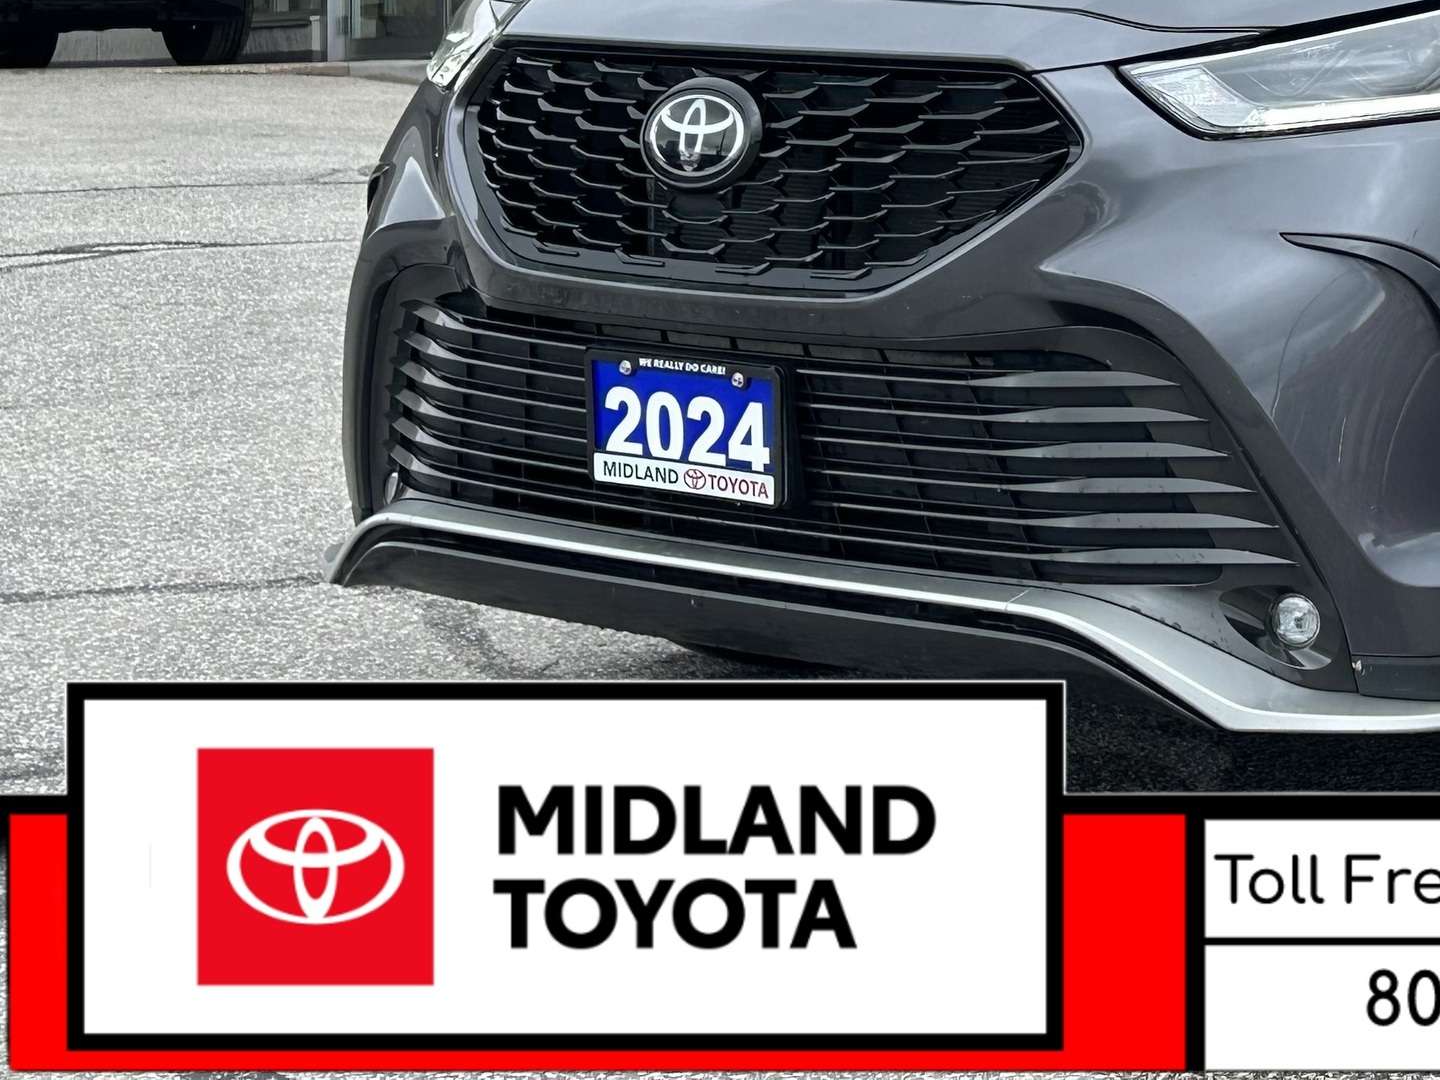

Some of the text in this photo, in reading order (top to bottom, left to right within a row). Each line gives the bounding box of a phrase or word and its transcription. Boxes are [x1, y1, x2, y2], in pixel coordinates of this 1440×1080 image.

[638, 357, 727, 376] WE REALLY DO CARE!
[604, 385, 771, 473] 2024
[603, 460, 769, 499] MIDLAND TOYOTA
